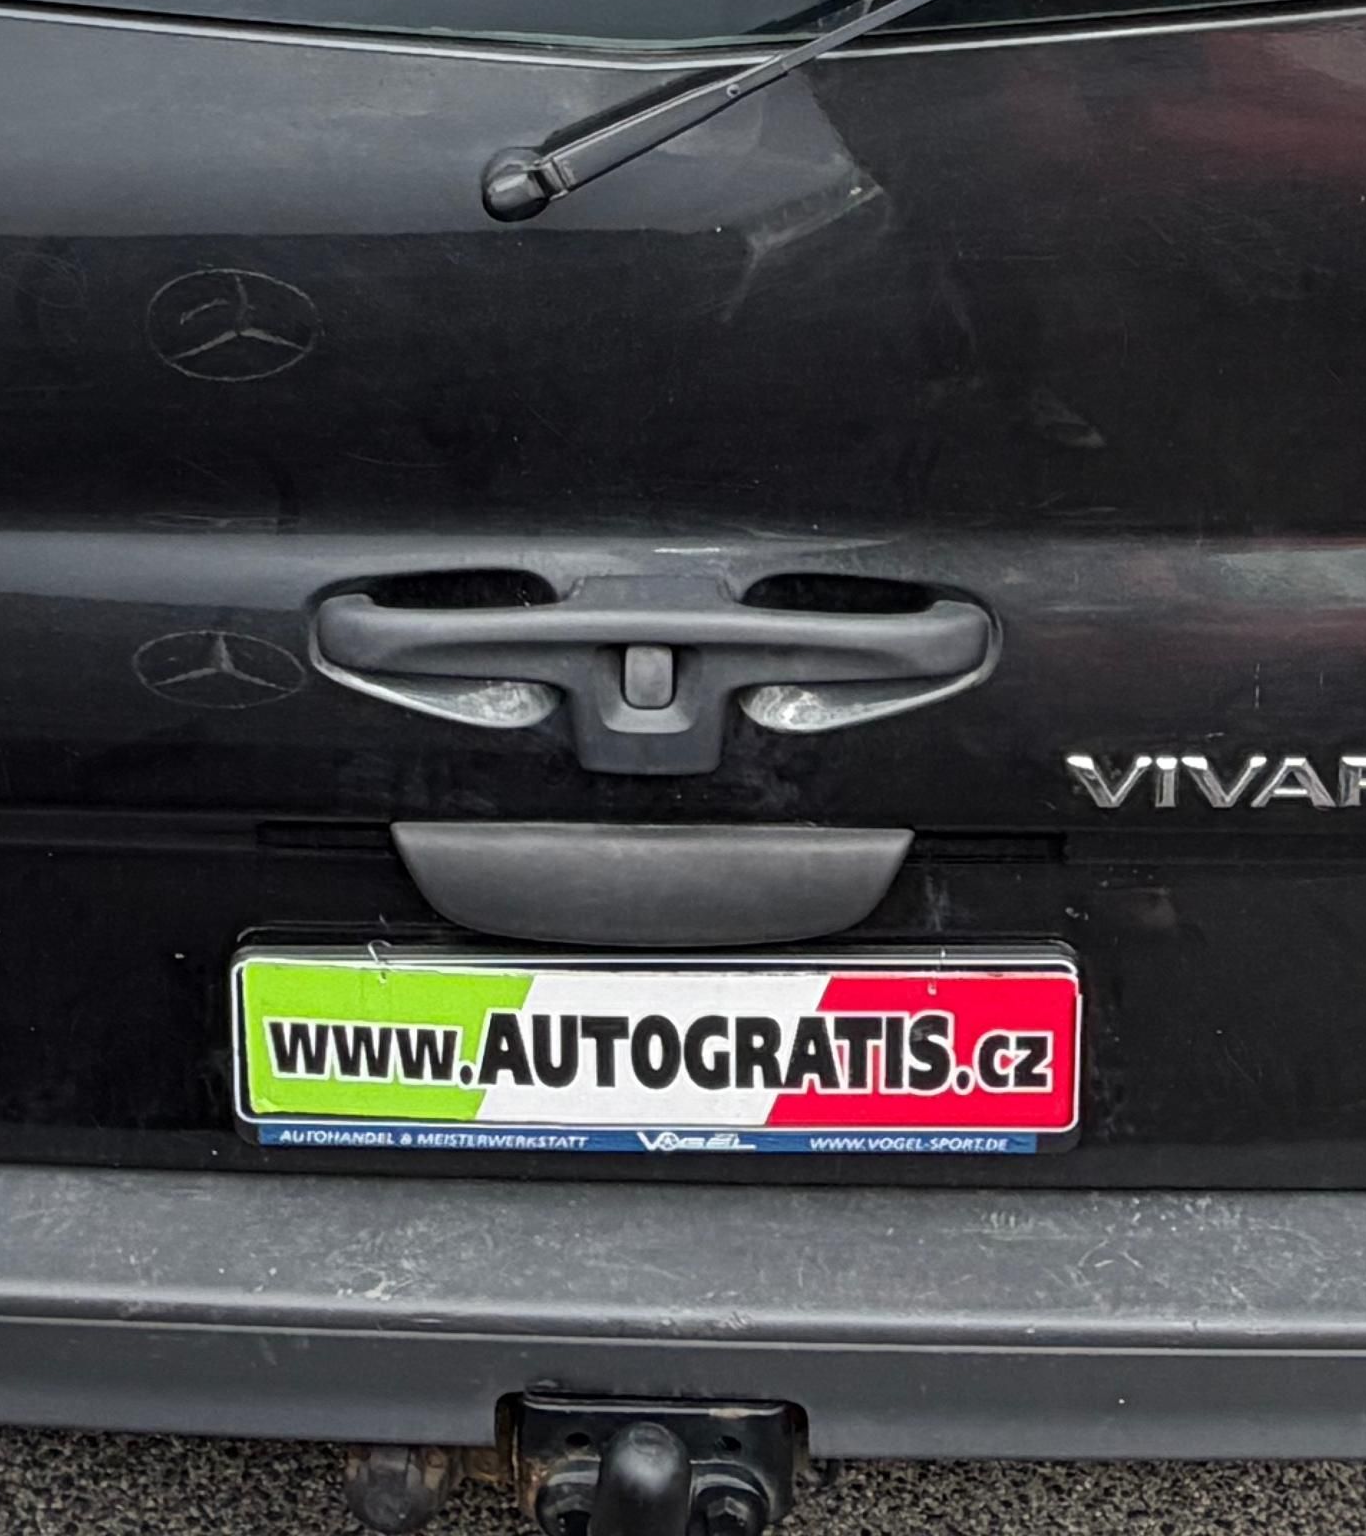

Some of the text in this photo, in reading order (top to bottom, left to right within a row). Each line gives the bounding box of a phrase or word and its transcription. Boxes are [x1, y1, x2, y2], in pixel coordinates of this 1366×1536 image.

[279, 1129, 590, 1149] AUTOHANDEL & MEISTERWERKSTATT
[637, 1131, 757, 1151] VOGEL
[809, 1136, 1008, 1152] WWW.VOGEL-SPORT.DE
